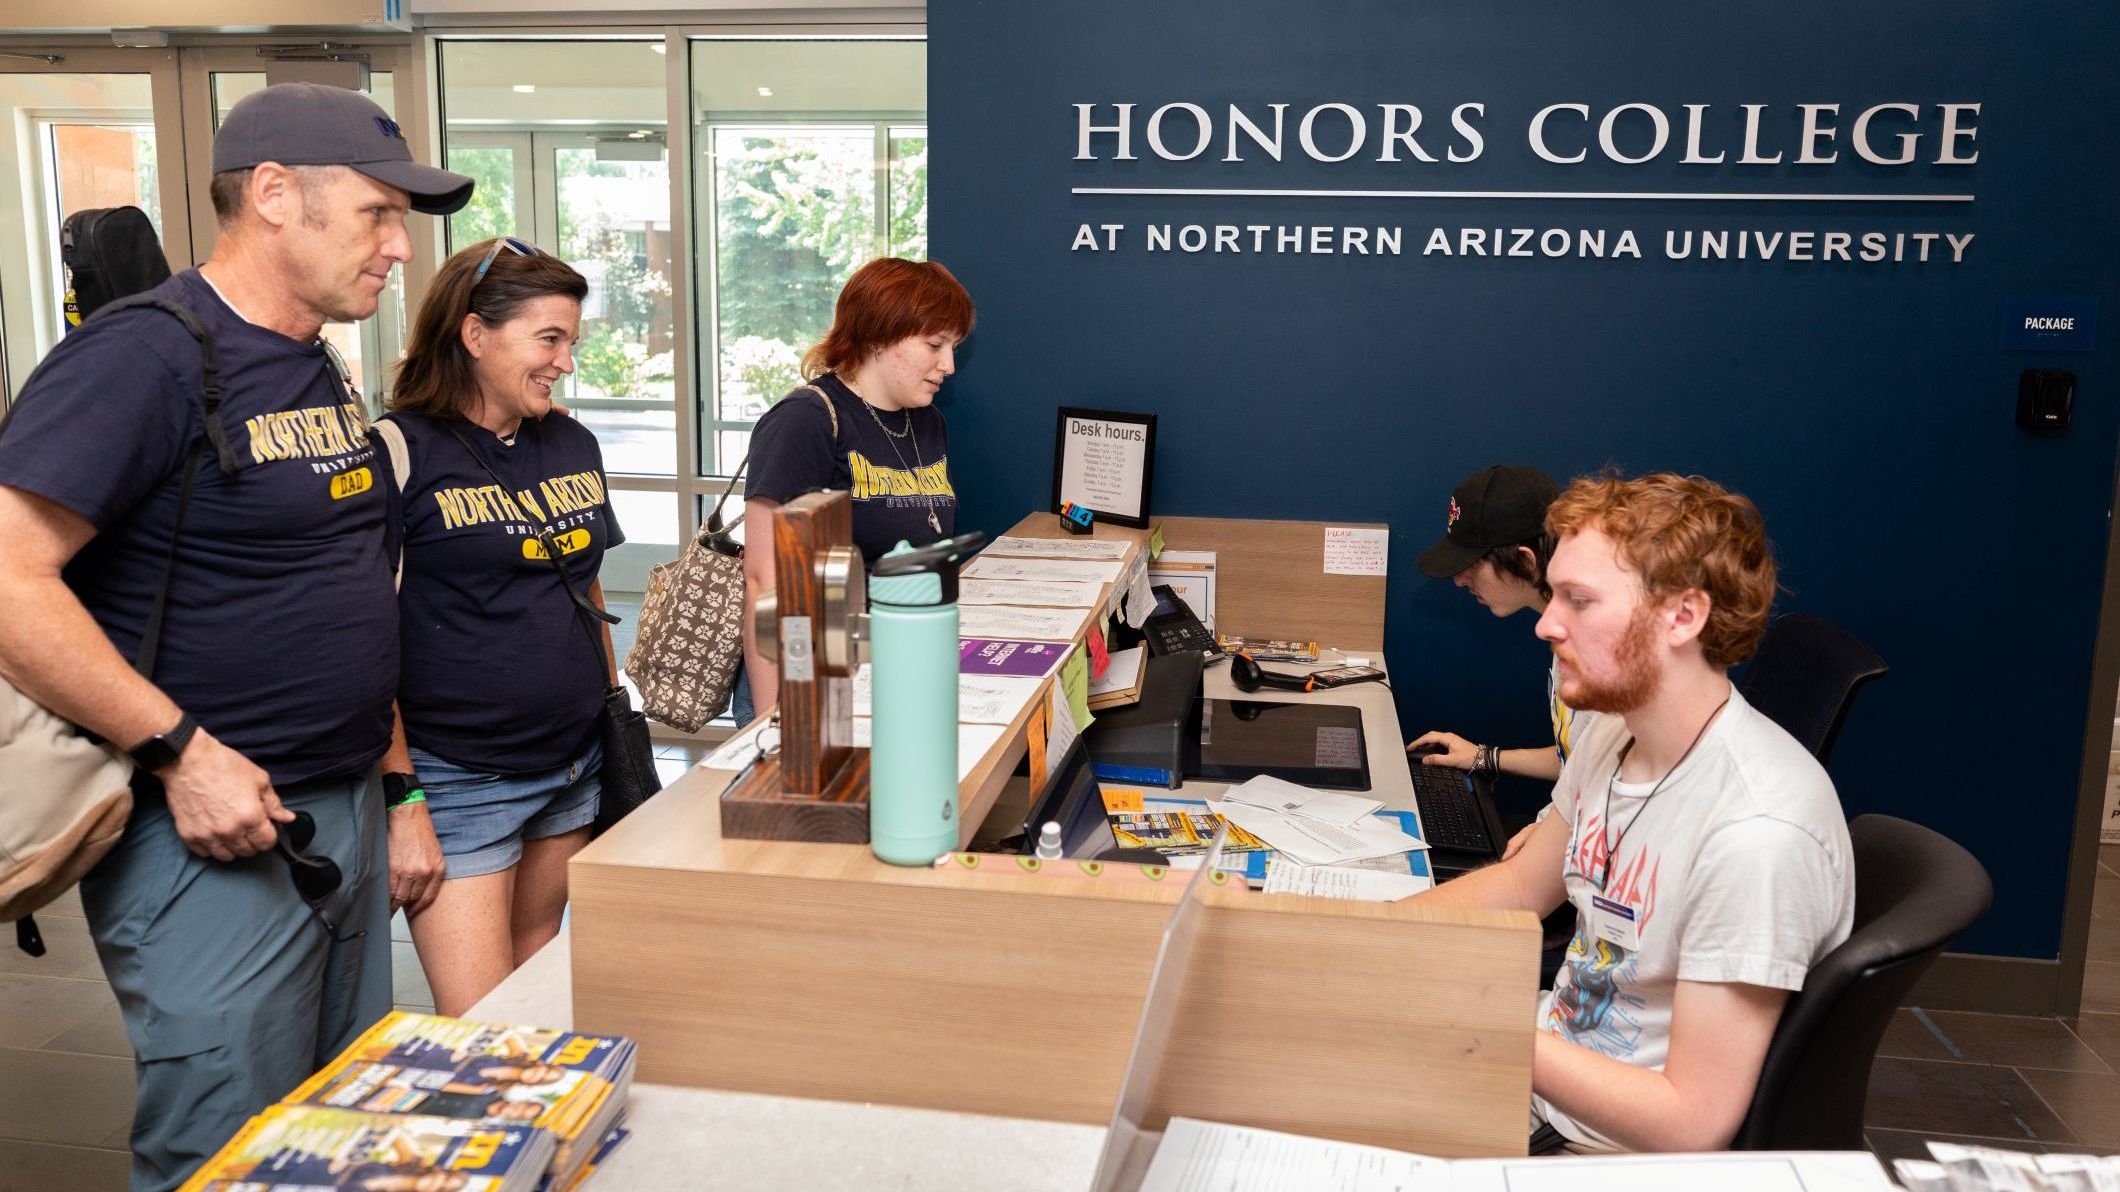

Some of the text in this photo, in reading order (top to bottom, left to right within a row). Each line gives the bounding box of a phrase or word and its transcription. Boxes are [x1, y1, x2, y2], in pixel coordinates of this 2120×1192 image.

[1072, 102, 1981, 165] HONORS COLLEGE
[1071, 223, 1976, 263] AT NORTHERN ARIZONA UNIVERSITY
[2024, 317, 2075, 330] PACKAGE
[1072, 420, 1145, 442] Desk hours.
[340, 472, 363, 495] DAD
[434, 485, 547, 530] NORTHN
[506, 511, 596, 536] UNIRSITY
[535, 534, 575, 557] MM
